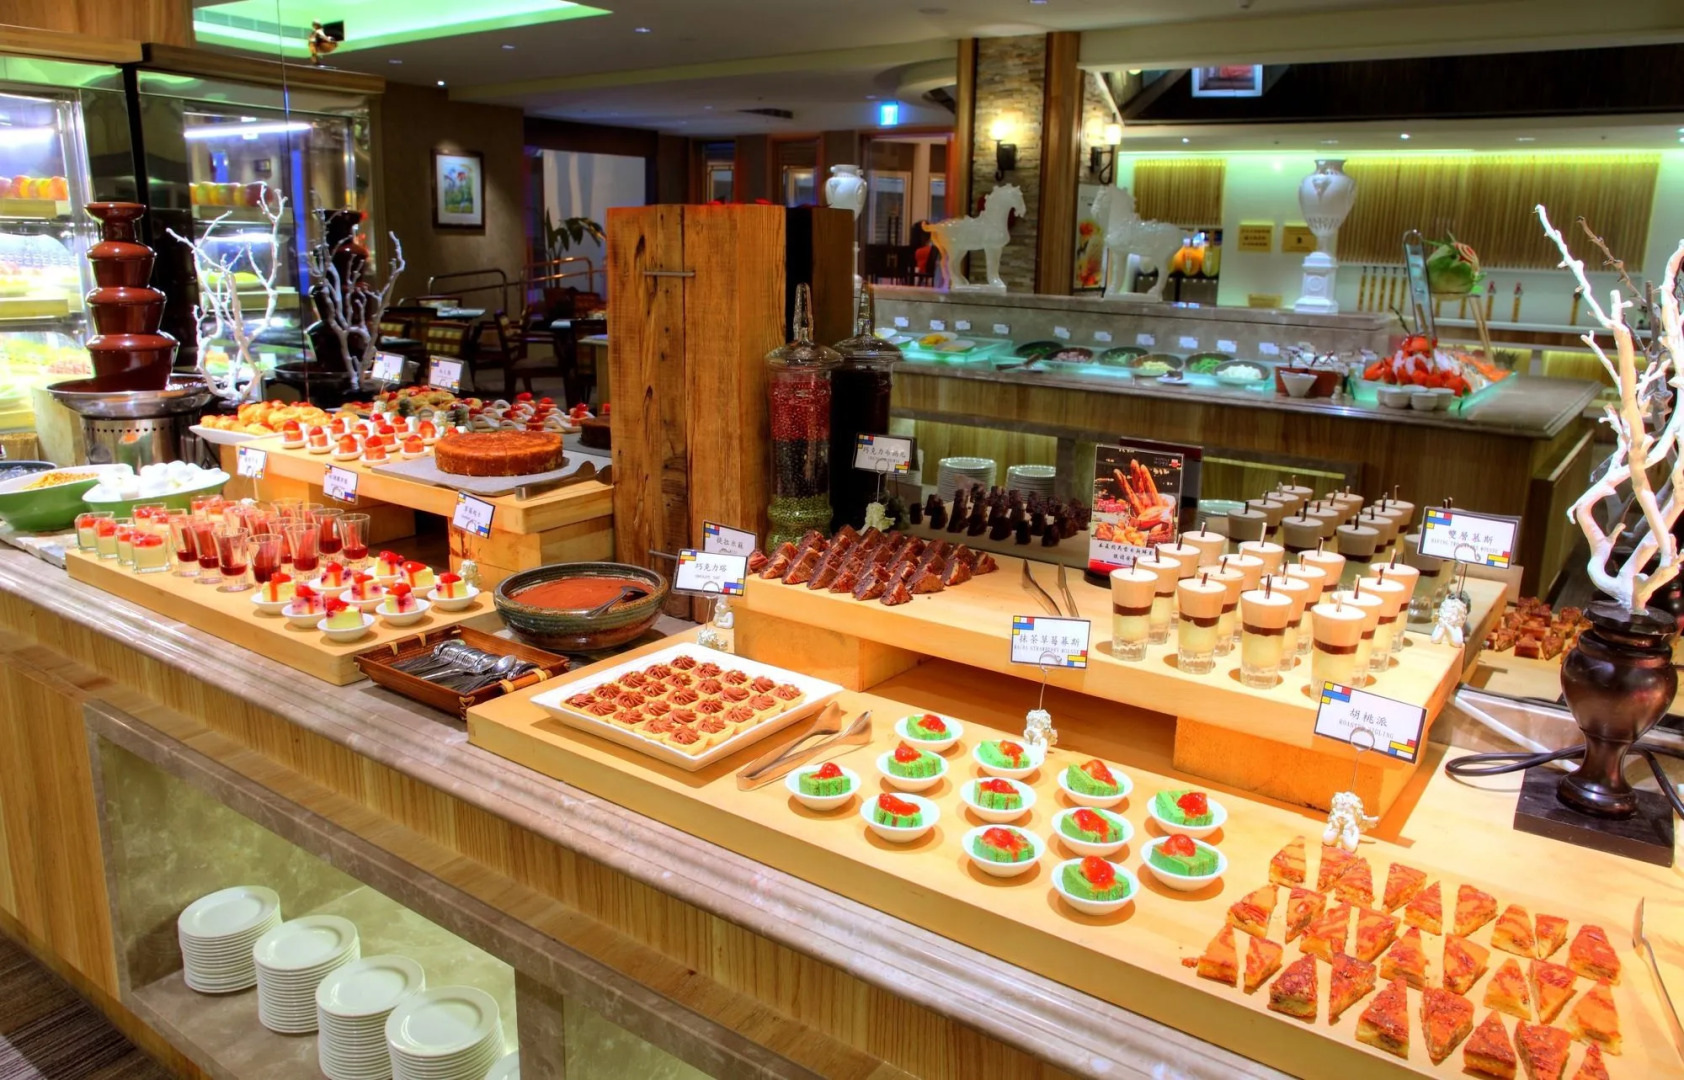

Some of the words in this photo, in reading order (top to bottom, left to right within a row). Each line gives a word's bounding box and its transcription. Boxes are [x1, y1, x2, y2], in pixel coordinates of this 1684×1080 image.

[694, 563, 728, 572] 巧克力塔
[1019, 633, 1080, 647] 抹茶草莓慕斯
[1349, 707, 1389, 728] 胡桃派
